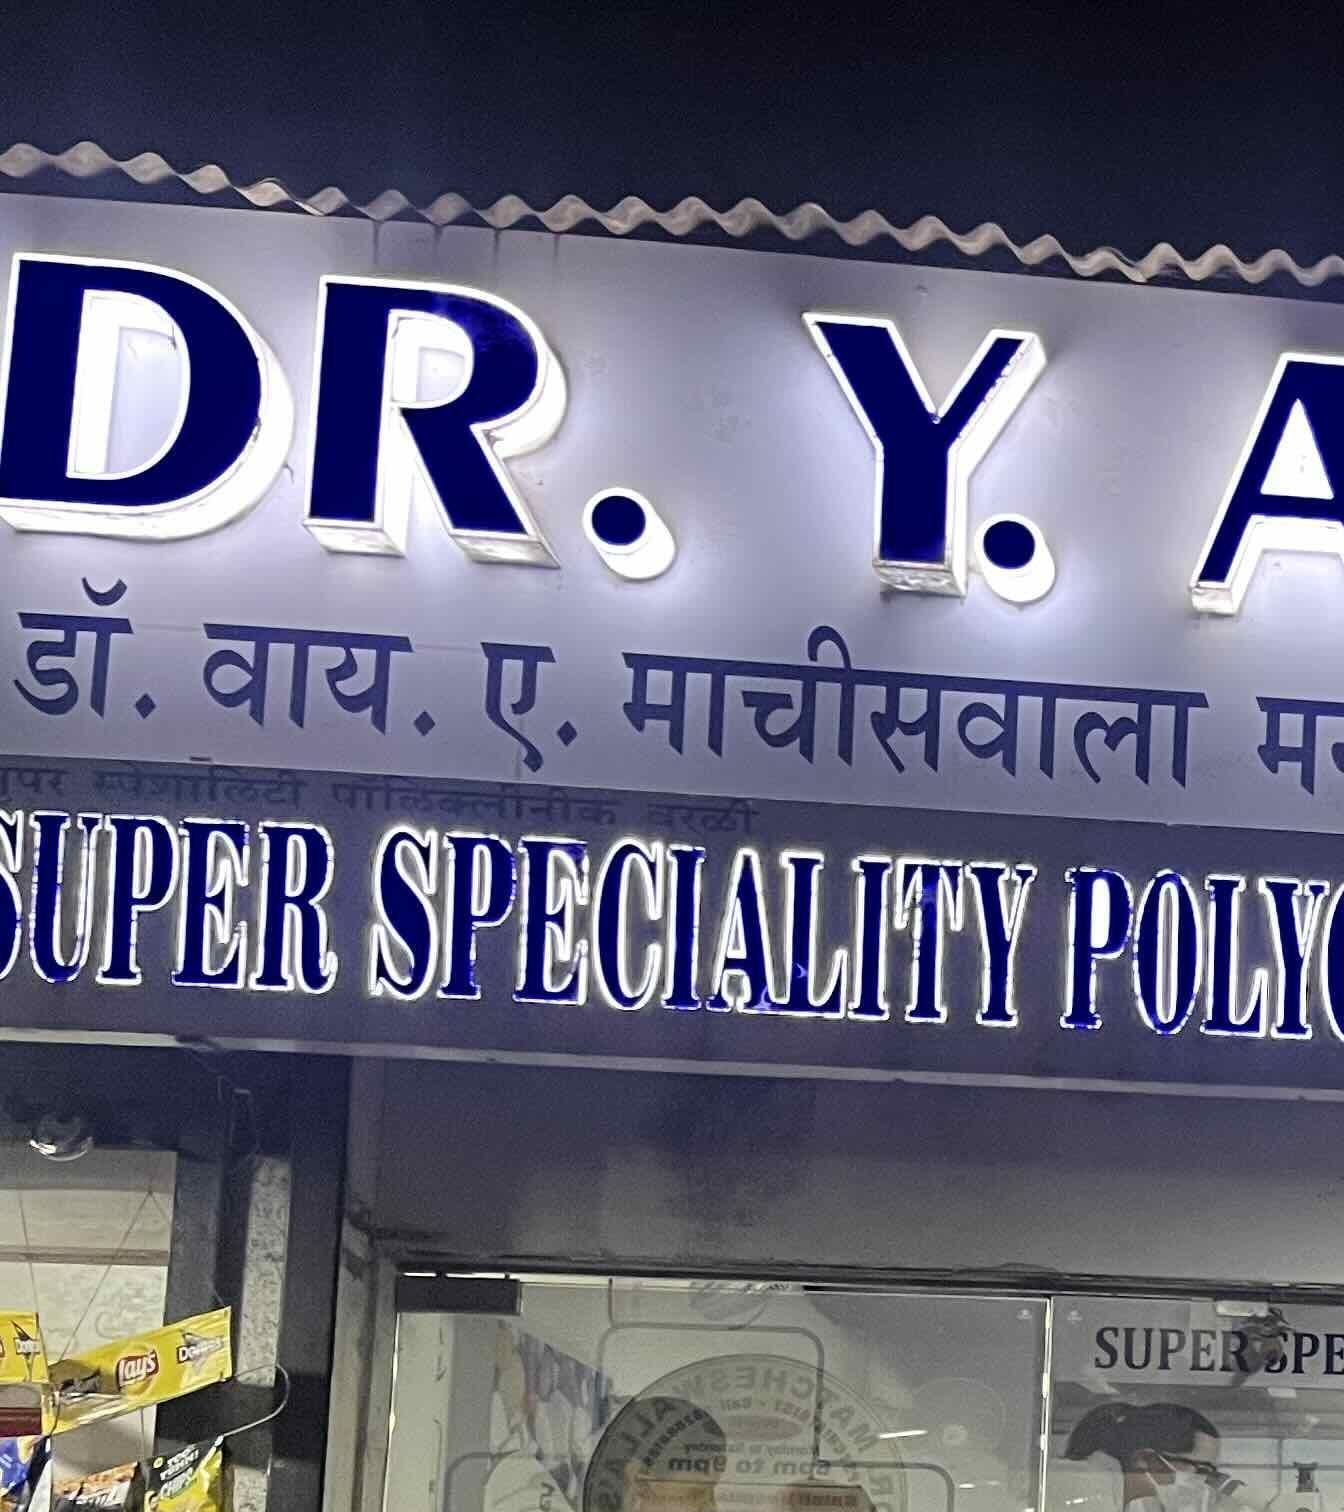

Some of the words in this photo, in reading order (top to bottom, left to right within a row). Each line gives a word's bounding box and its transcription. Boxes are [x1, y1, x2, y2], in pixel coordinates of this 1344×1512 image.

[2, 253, 675, 581] DR.
[805, 312, 1055, 603] Y.
[14, 578, 158, 719] डॉ.
[203, 622, 436, 736] वाय.
[480, 642, 580, 772] ए.
[623, 626, 1207, 786] माचीसवाला
[369, 822, 1036, 1028] SPECIALITY
[1094, 1327, 1251, 1374] SUPER
